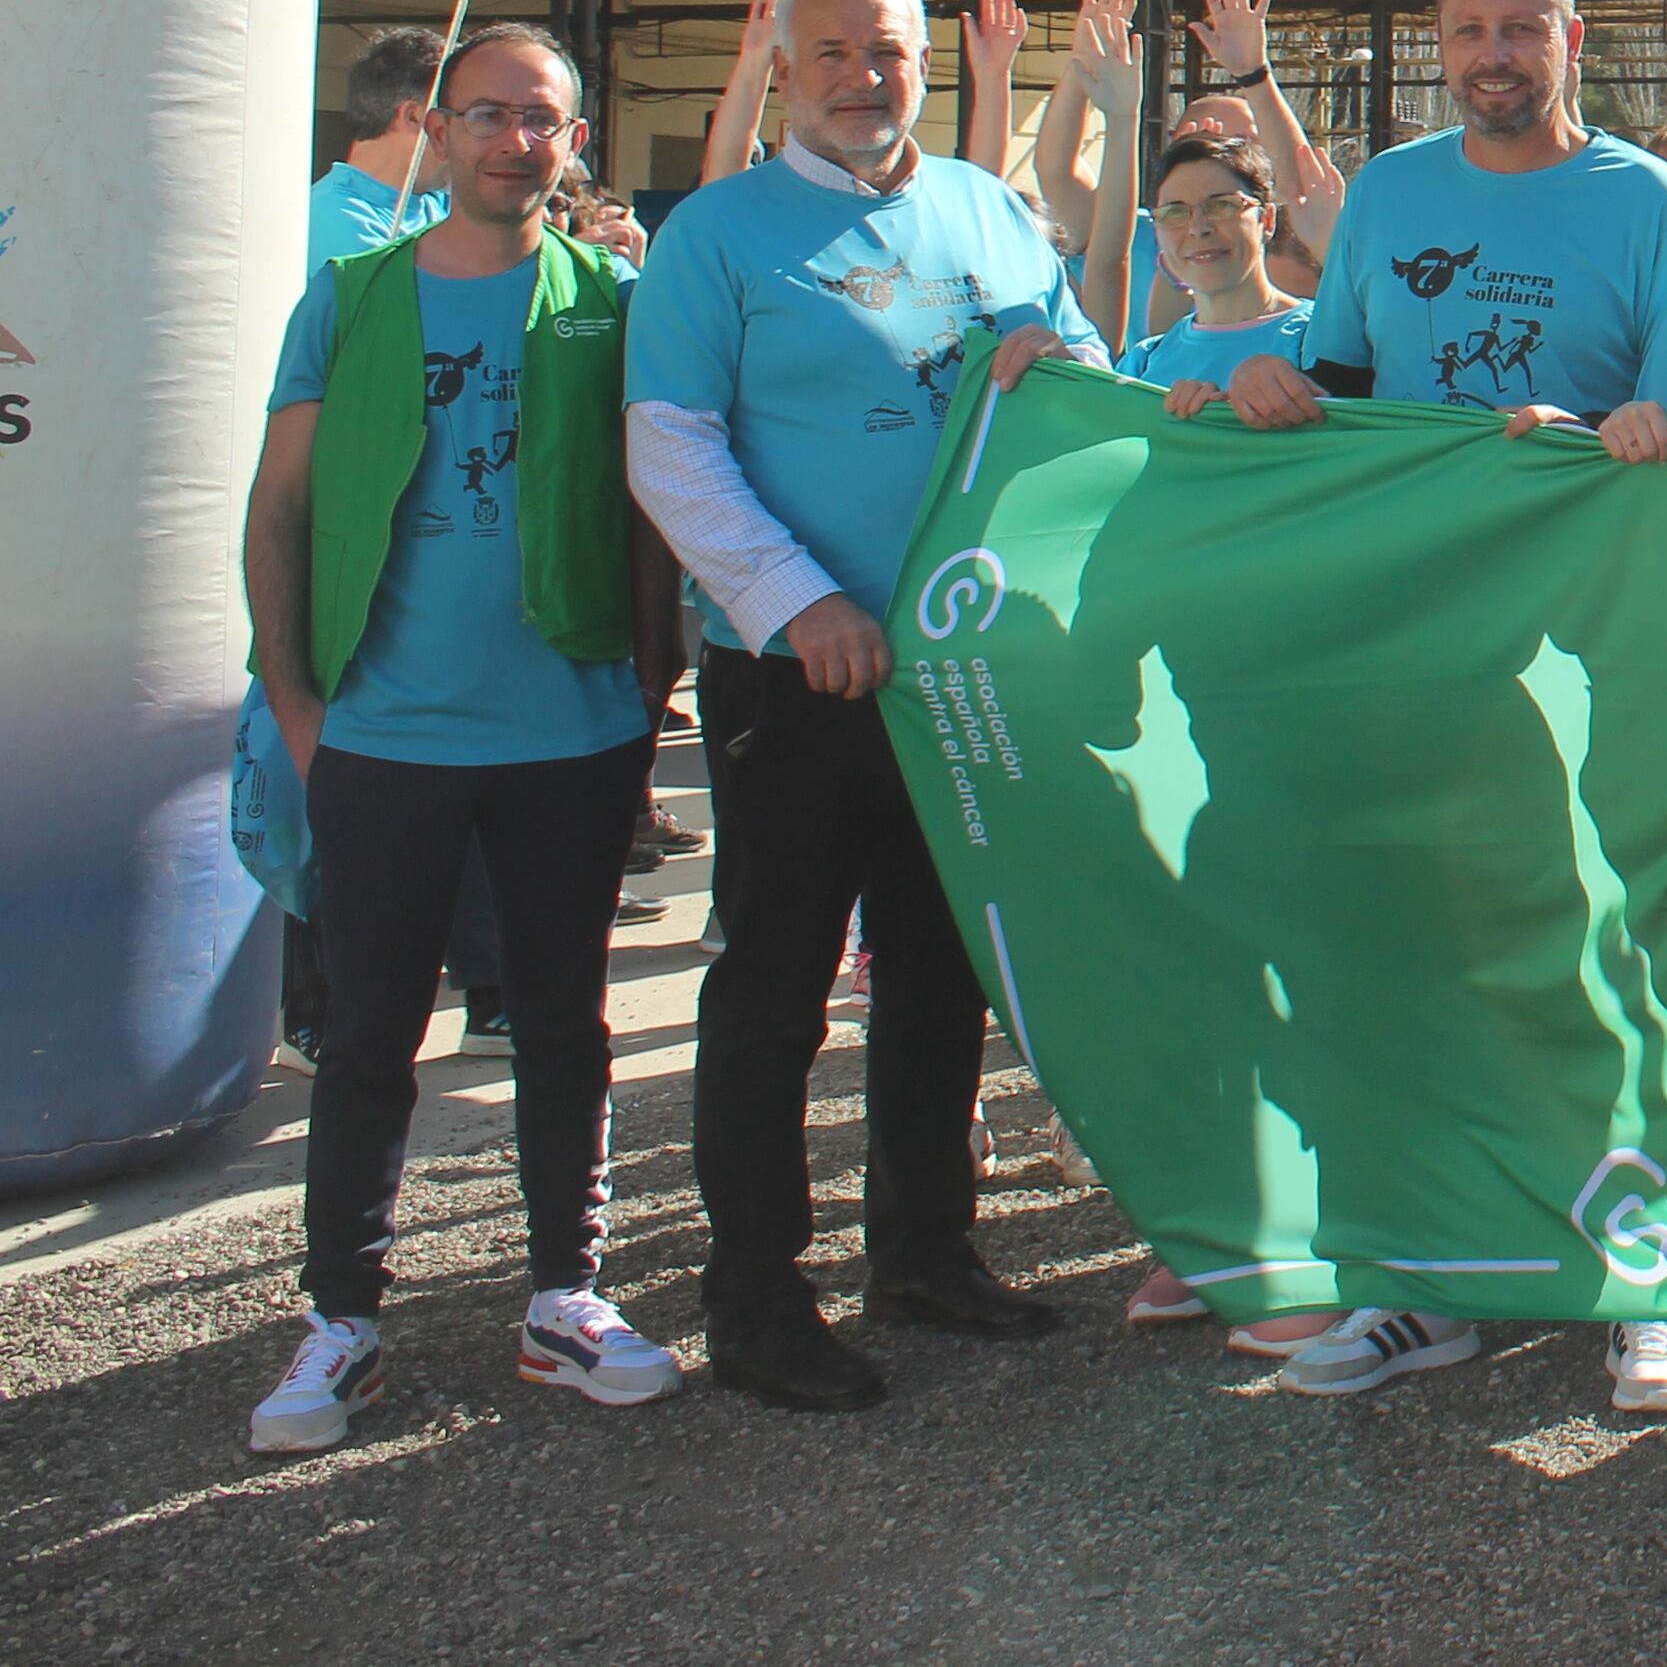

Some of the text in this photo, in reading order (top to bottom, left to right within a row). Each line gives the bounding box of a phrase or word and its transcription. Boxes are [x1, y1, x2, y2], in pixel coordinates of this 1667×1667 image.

[1465, 285, 1555, 309] solidaria
[1472, 265, 1555, 289] Carrera
[915, 659, 989, 847] contra el cáncer
[944, 659, 990, 765] española
[972, 658, 1023, 781] asociación
